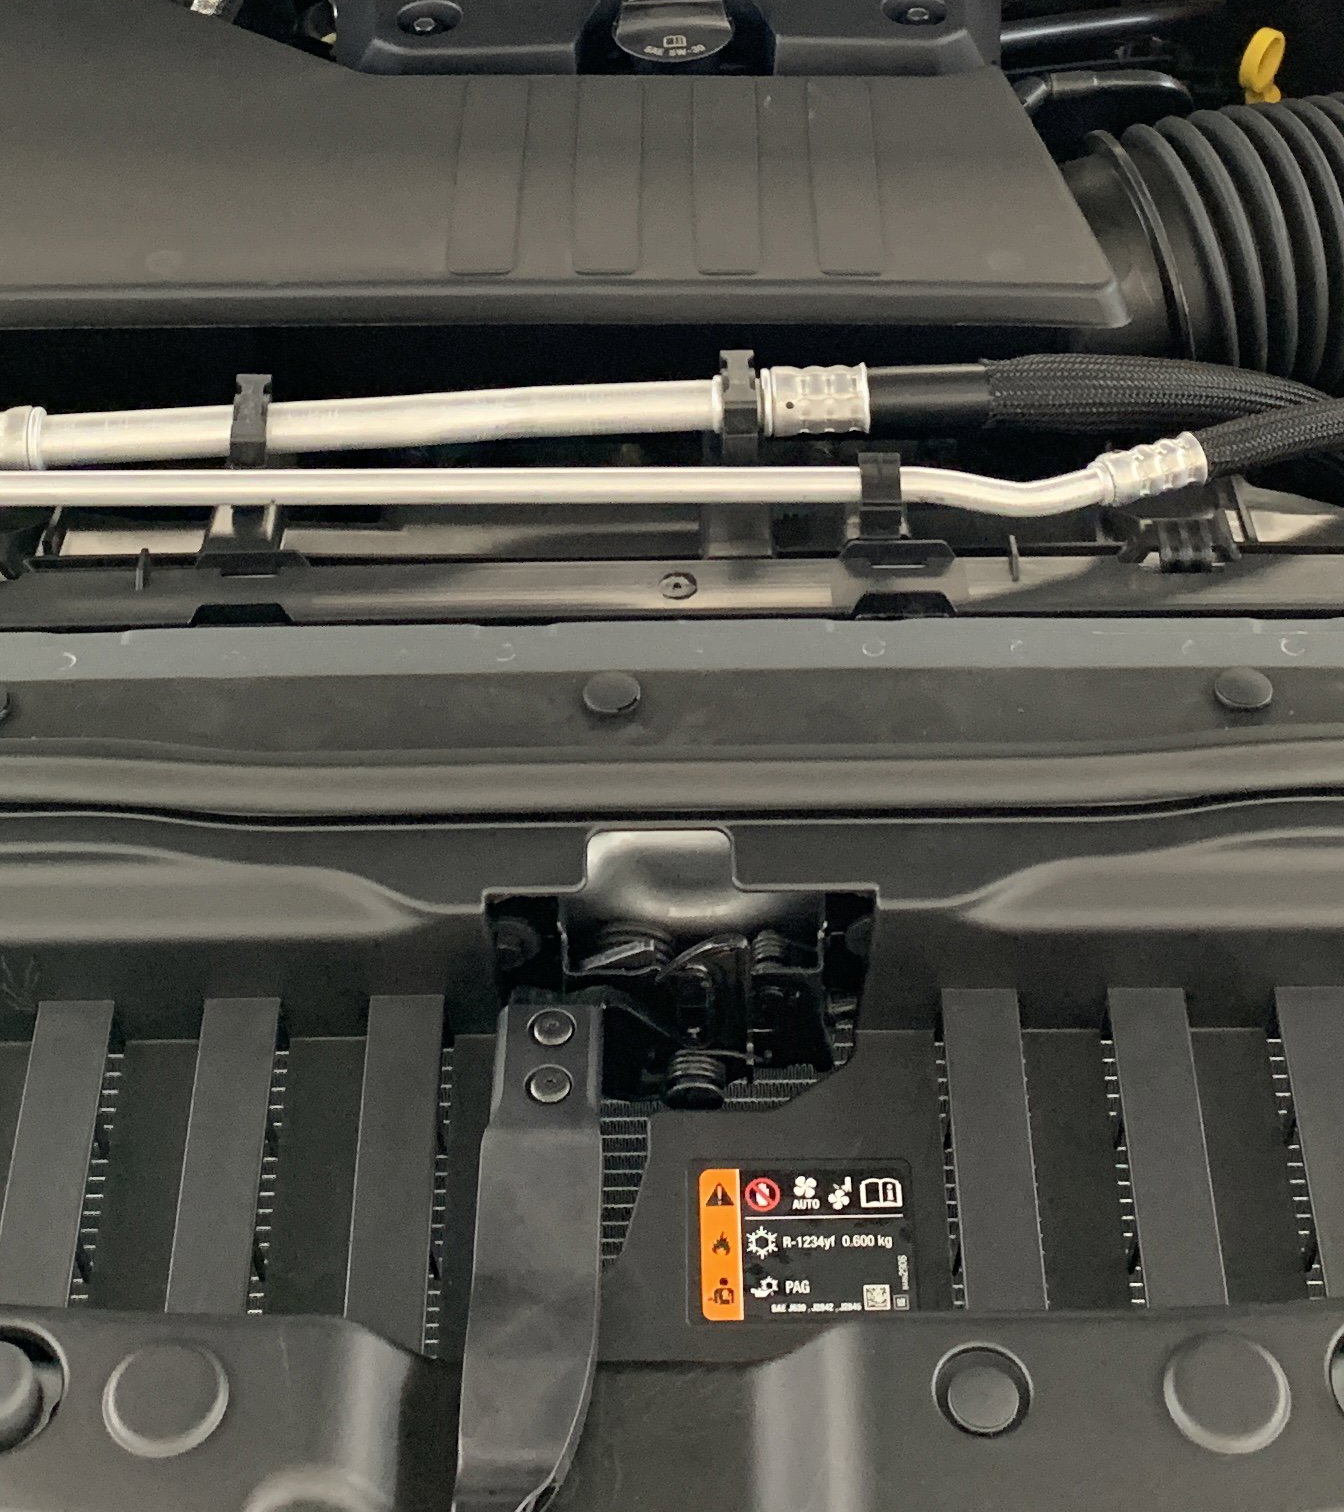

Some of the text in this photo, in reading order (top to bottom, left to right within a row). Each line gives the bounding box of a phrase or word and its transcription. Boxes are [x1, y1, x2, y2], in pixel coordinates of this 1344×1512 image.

[792, 1198, 821, 1210] AUTO
[782, 1234, 893, 1250] R-1234yf 0.600 kg
[785, 1280, 810, 1294] PAG
